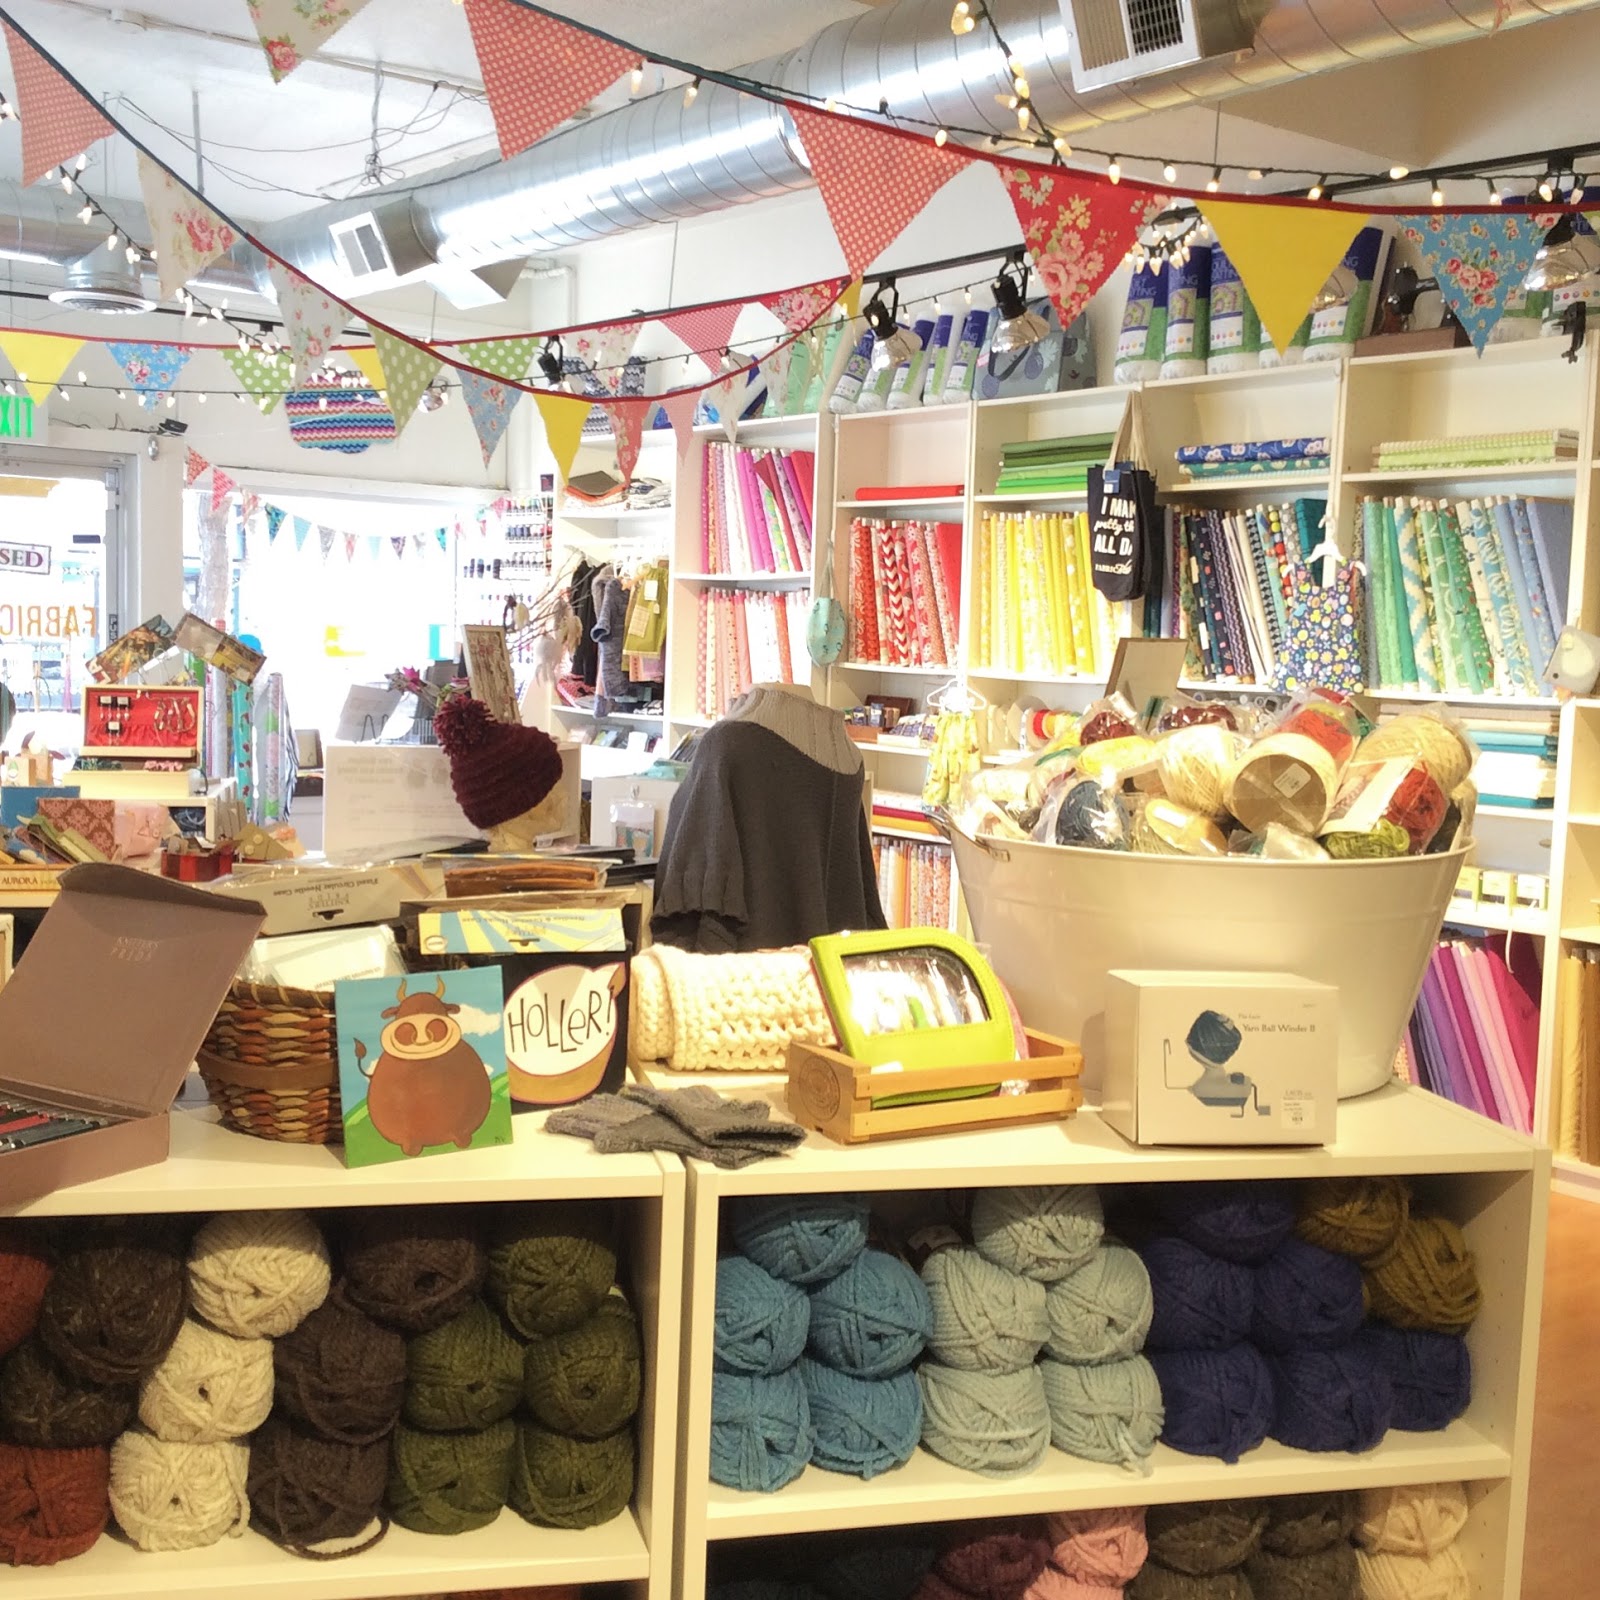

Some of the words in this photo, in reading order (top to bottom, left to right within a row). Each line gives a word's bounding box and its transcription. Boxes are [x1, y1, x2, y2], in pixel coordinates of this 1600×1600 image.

[0, 396, 33, 437] XIT
[1094, 534, 1116, 554] ALL
[0, 549, 43, 568] SED
[109, 617, 118, 642] PUS
[1, 876, 38, 885] AURORA
[324, 881, 355, 890] Circular
[294, 885, 321, 894] Needle
[1243, 1024, 1260, 1032] Yarn
[1261, 1023, 1276, 1032] Ball
[1277, 1024, 1308, 1032] Winder
